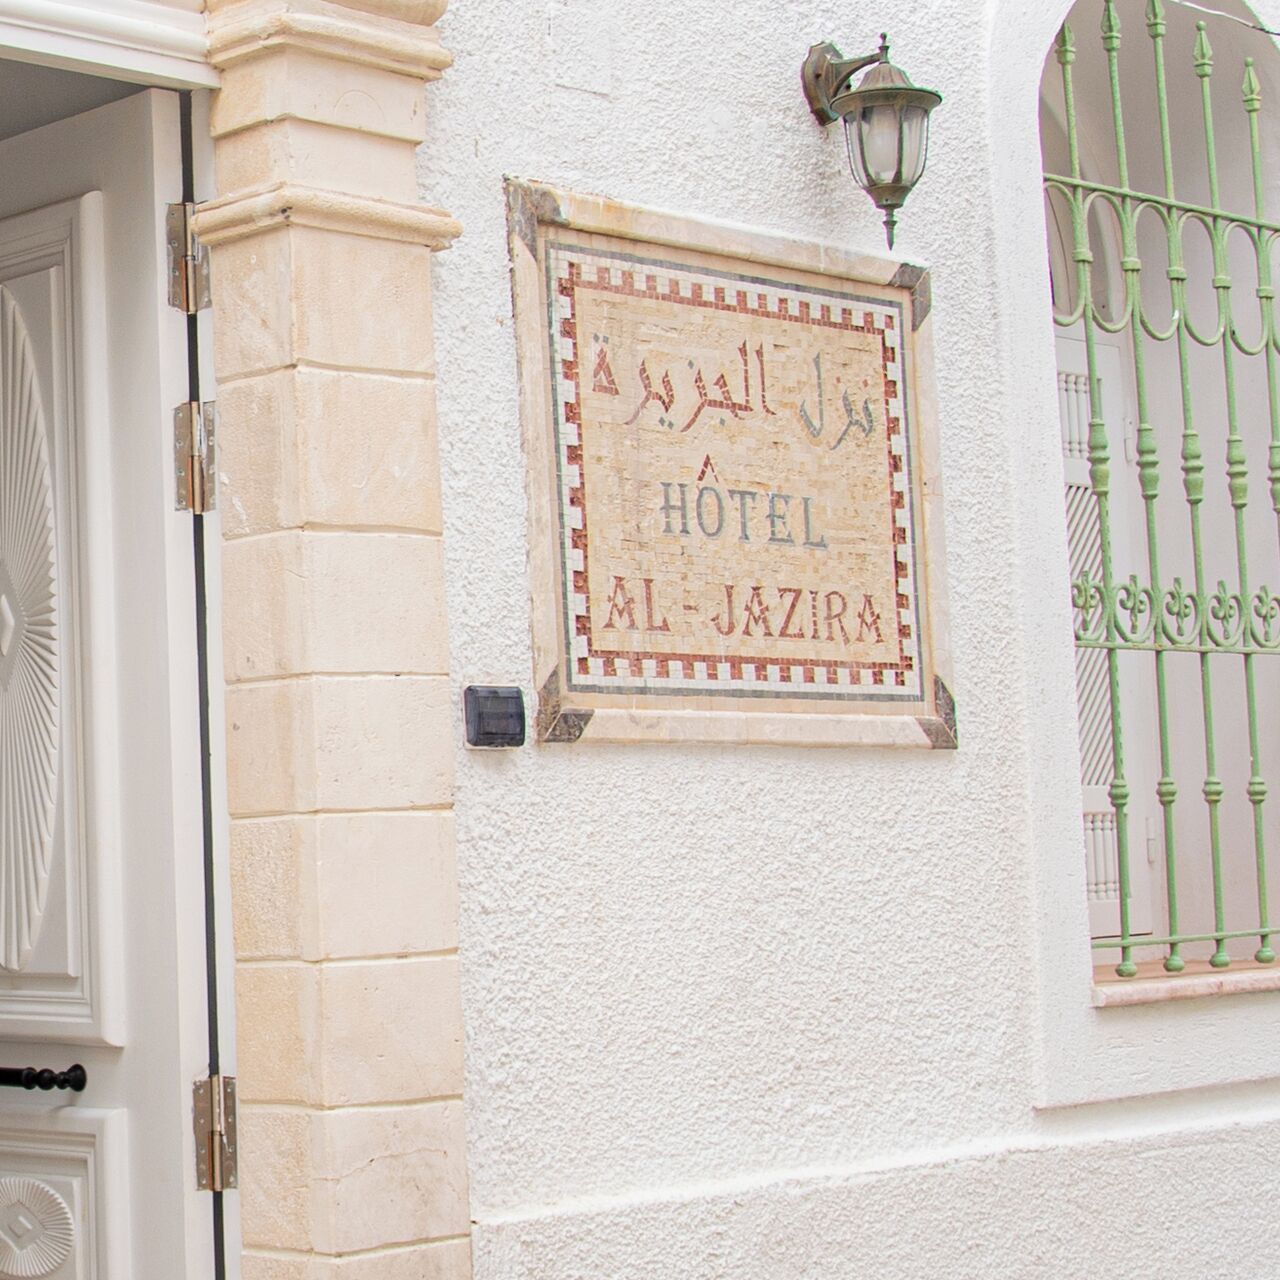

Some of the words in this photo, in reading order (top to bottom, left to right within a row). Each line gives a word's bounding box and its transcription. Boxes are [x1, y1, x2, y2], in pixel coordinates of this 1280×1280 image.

[591, 332, 777, 432] الجزيرة
[799, 351, 874, 451] نزل
[658, 454, 829, 549] HÔTEL
[711, 584, 885, 646] JAZIRA
